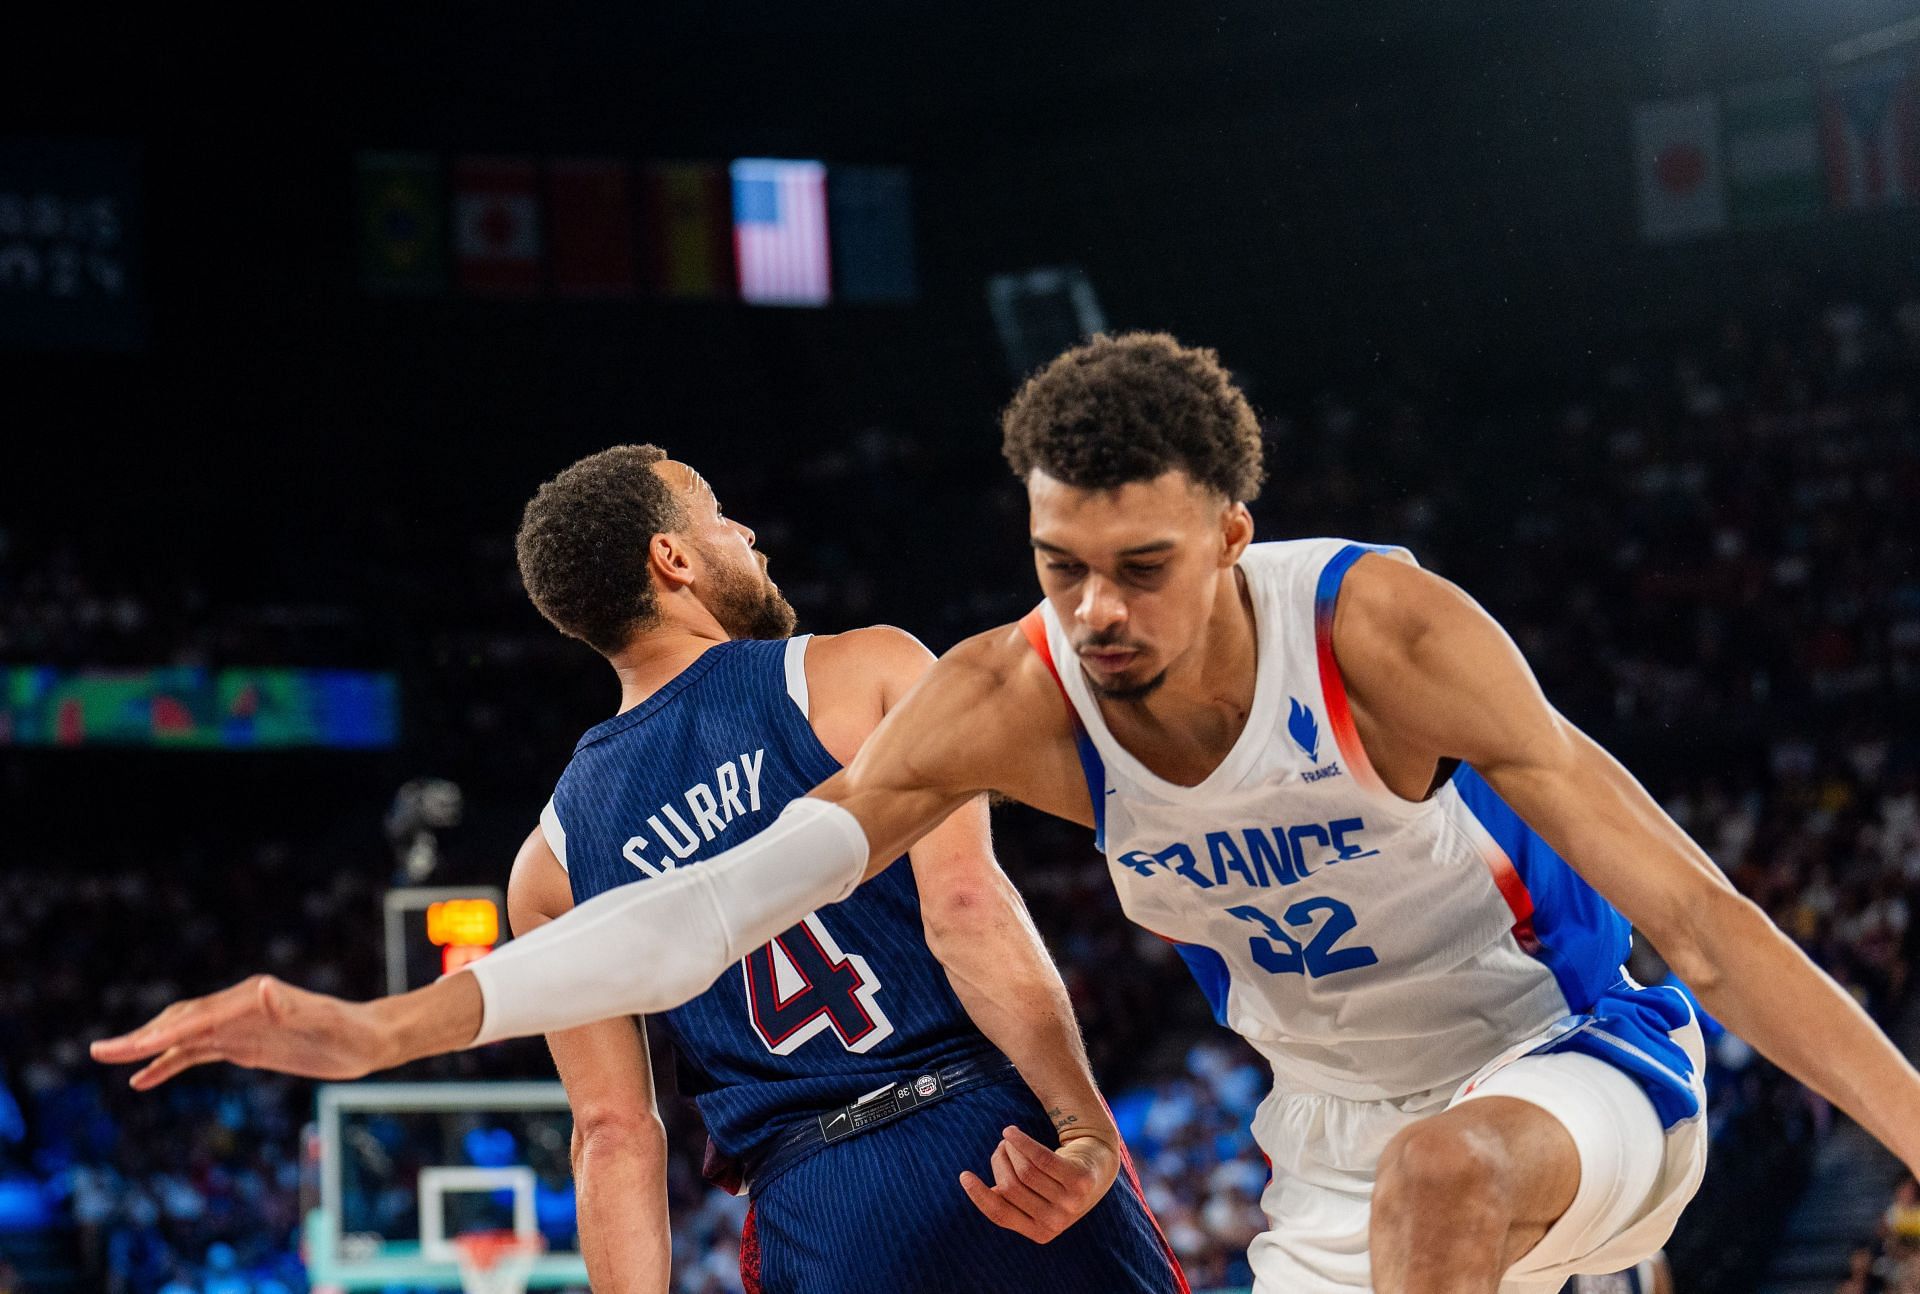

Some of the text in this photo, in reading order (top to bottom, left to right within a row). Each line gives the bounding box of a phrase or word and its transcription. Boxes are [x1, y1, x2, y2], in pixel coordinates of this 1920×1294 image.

[1301, 761, 1342, 784] FRANCE
[622, 748, 765, 880] CURRY
[1117, 816, 1380, 889] FRANCE
[1224, 896, 1379, 979] 32
[741, 911, 894, 1056] 4
[897, 1087, 910, 1099] 38
